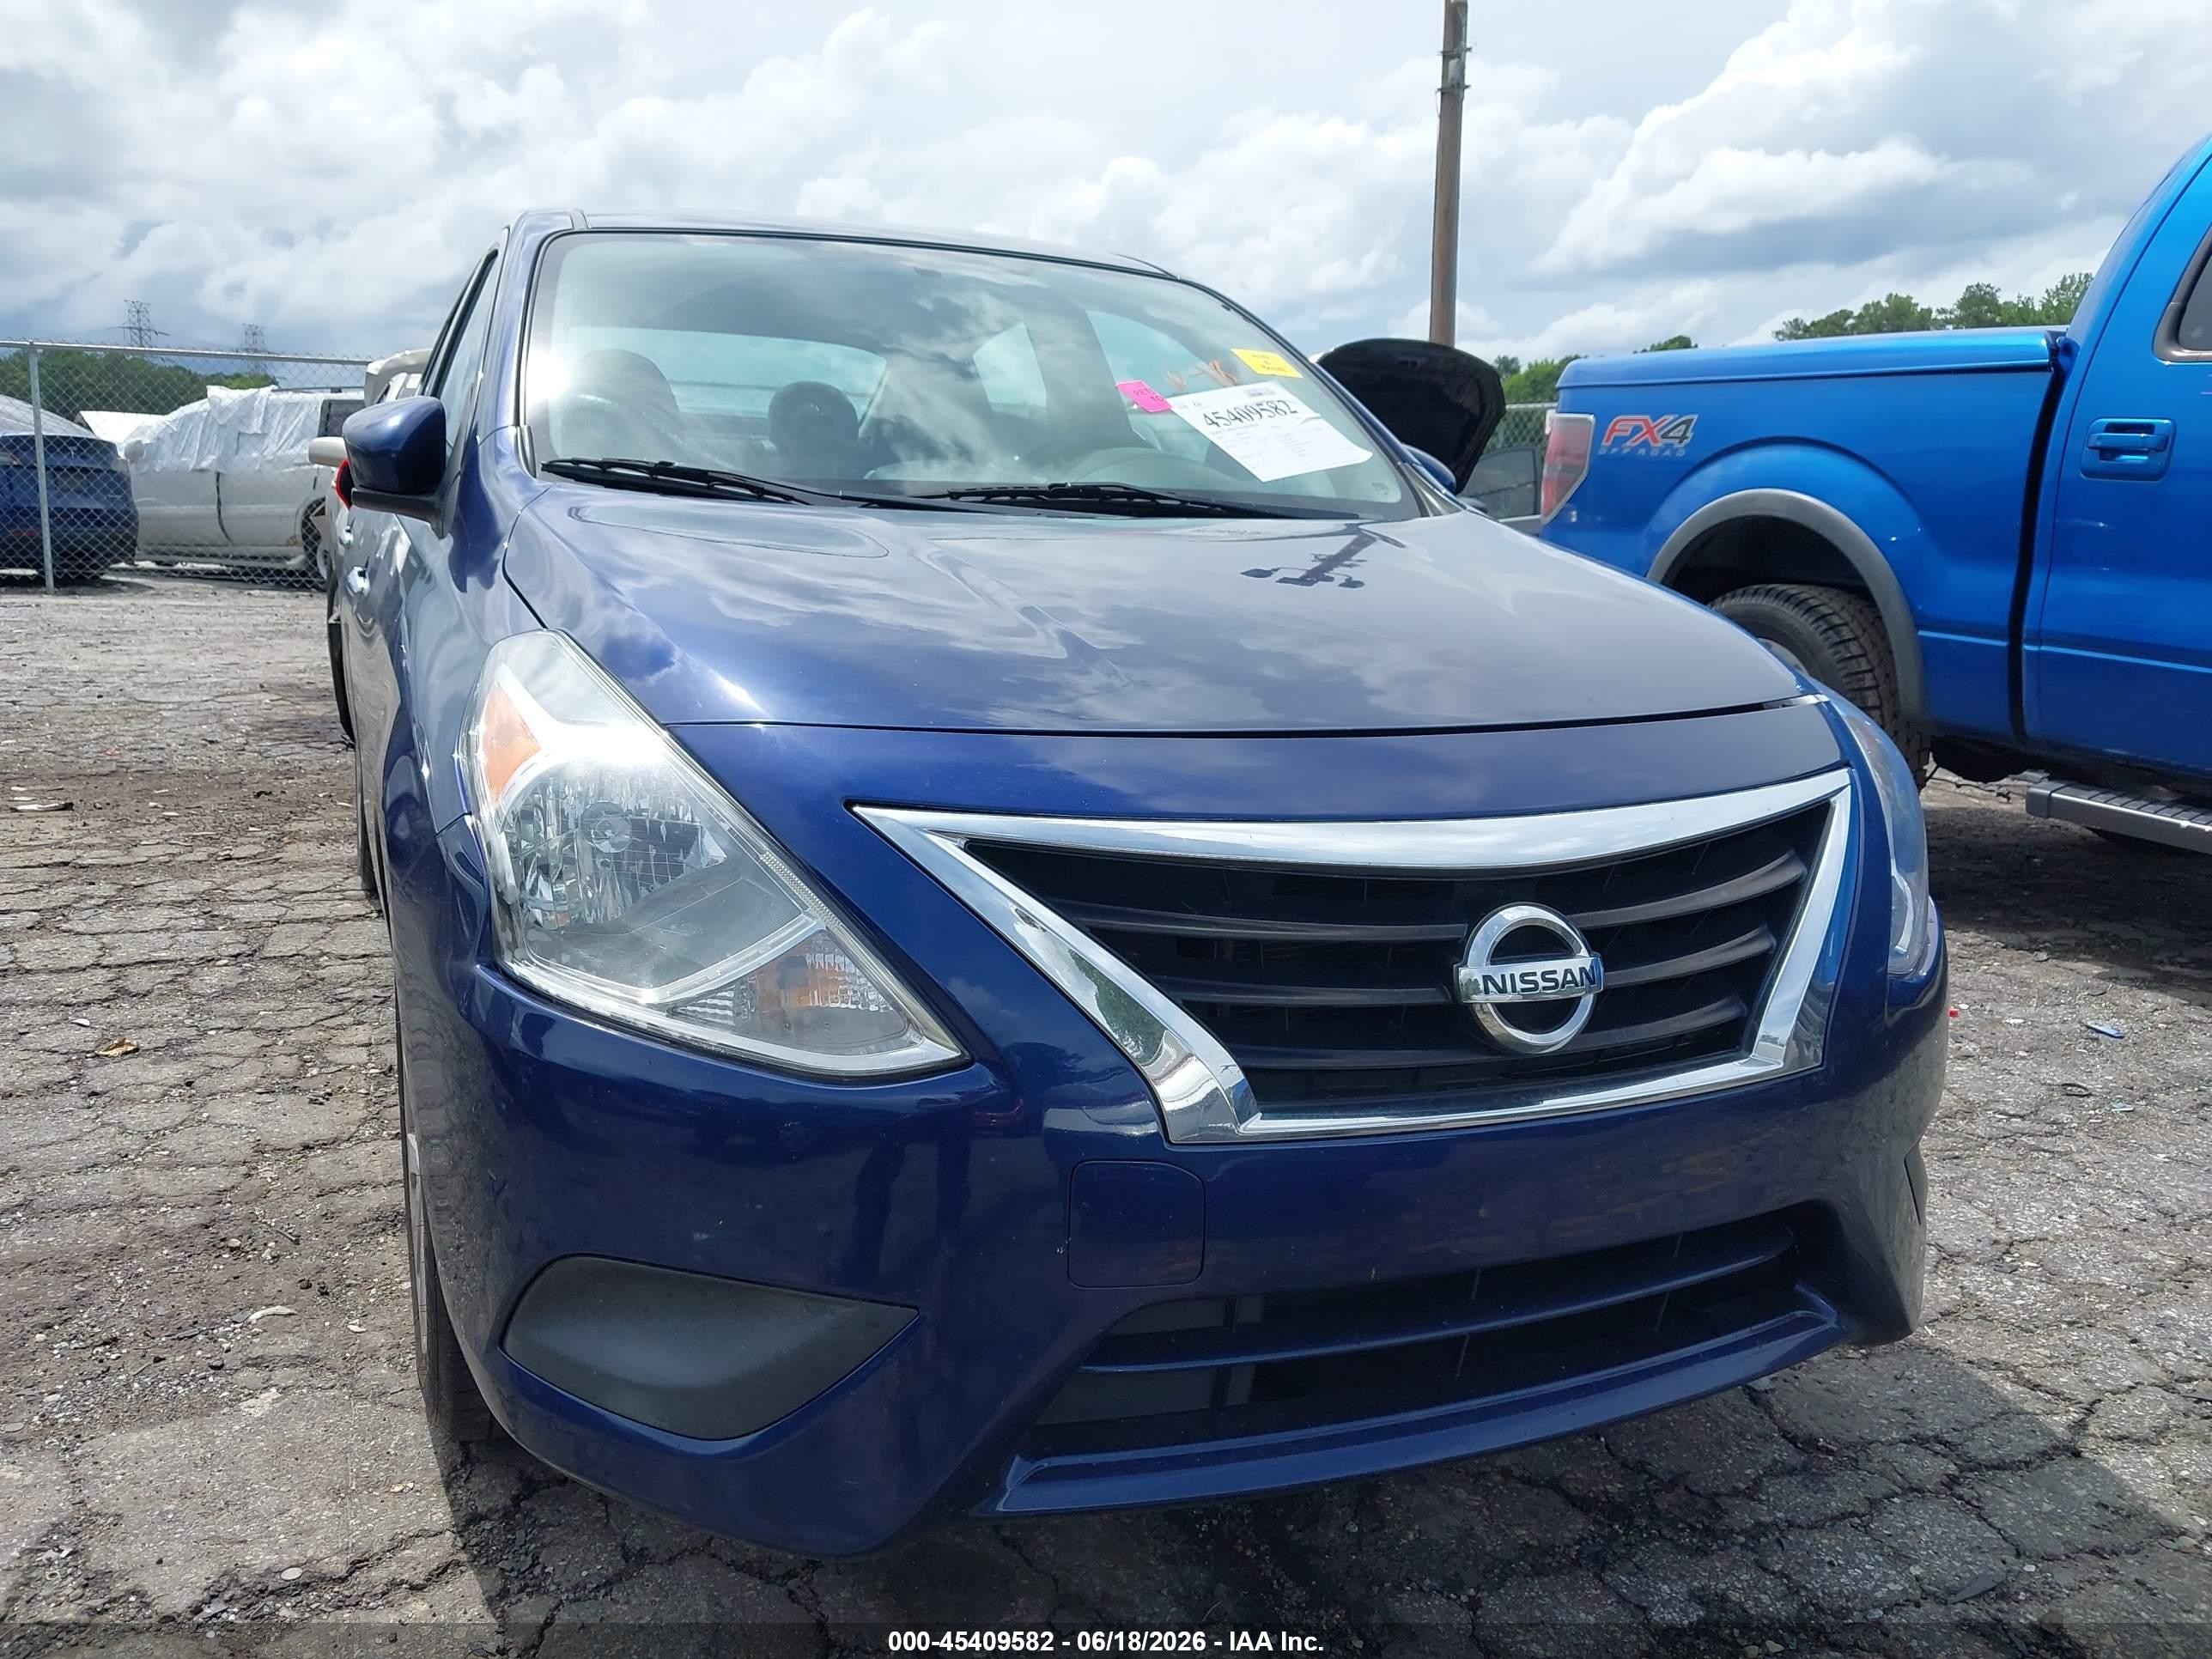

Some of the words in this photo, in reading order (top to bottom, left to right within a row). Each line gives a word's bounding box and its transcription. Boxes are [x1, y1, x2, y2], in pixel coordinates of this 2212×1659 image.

[1203, 399, 1298, 428] 45409582
[1601, 414, 1698, 447] FX4
[1637, 447, 1686, 457] ROAD
[1481, 966, 1596, 995] NISSAN
